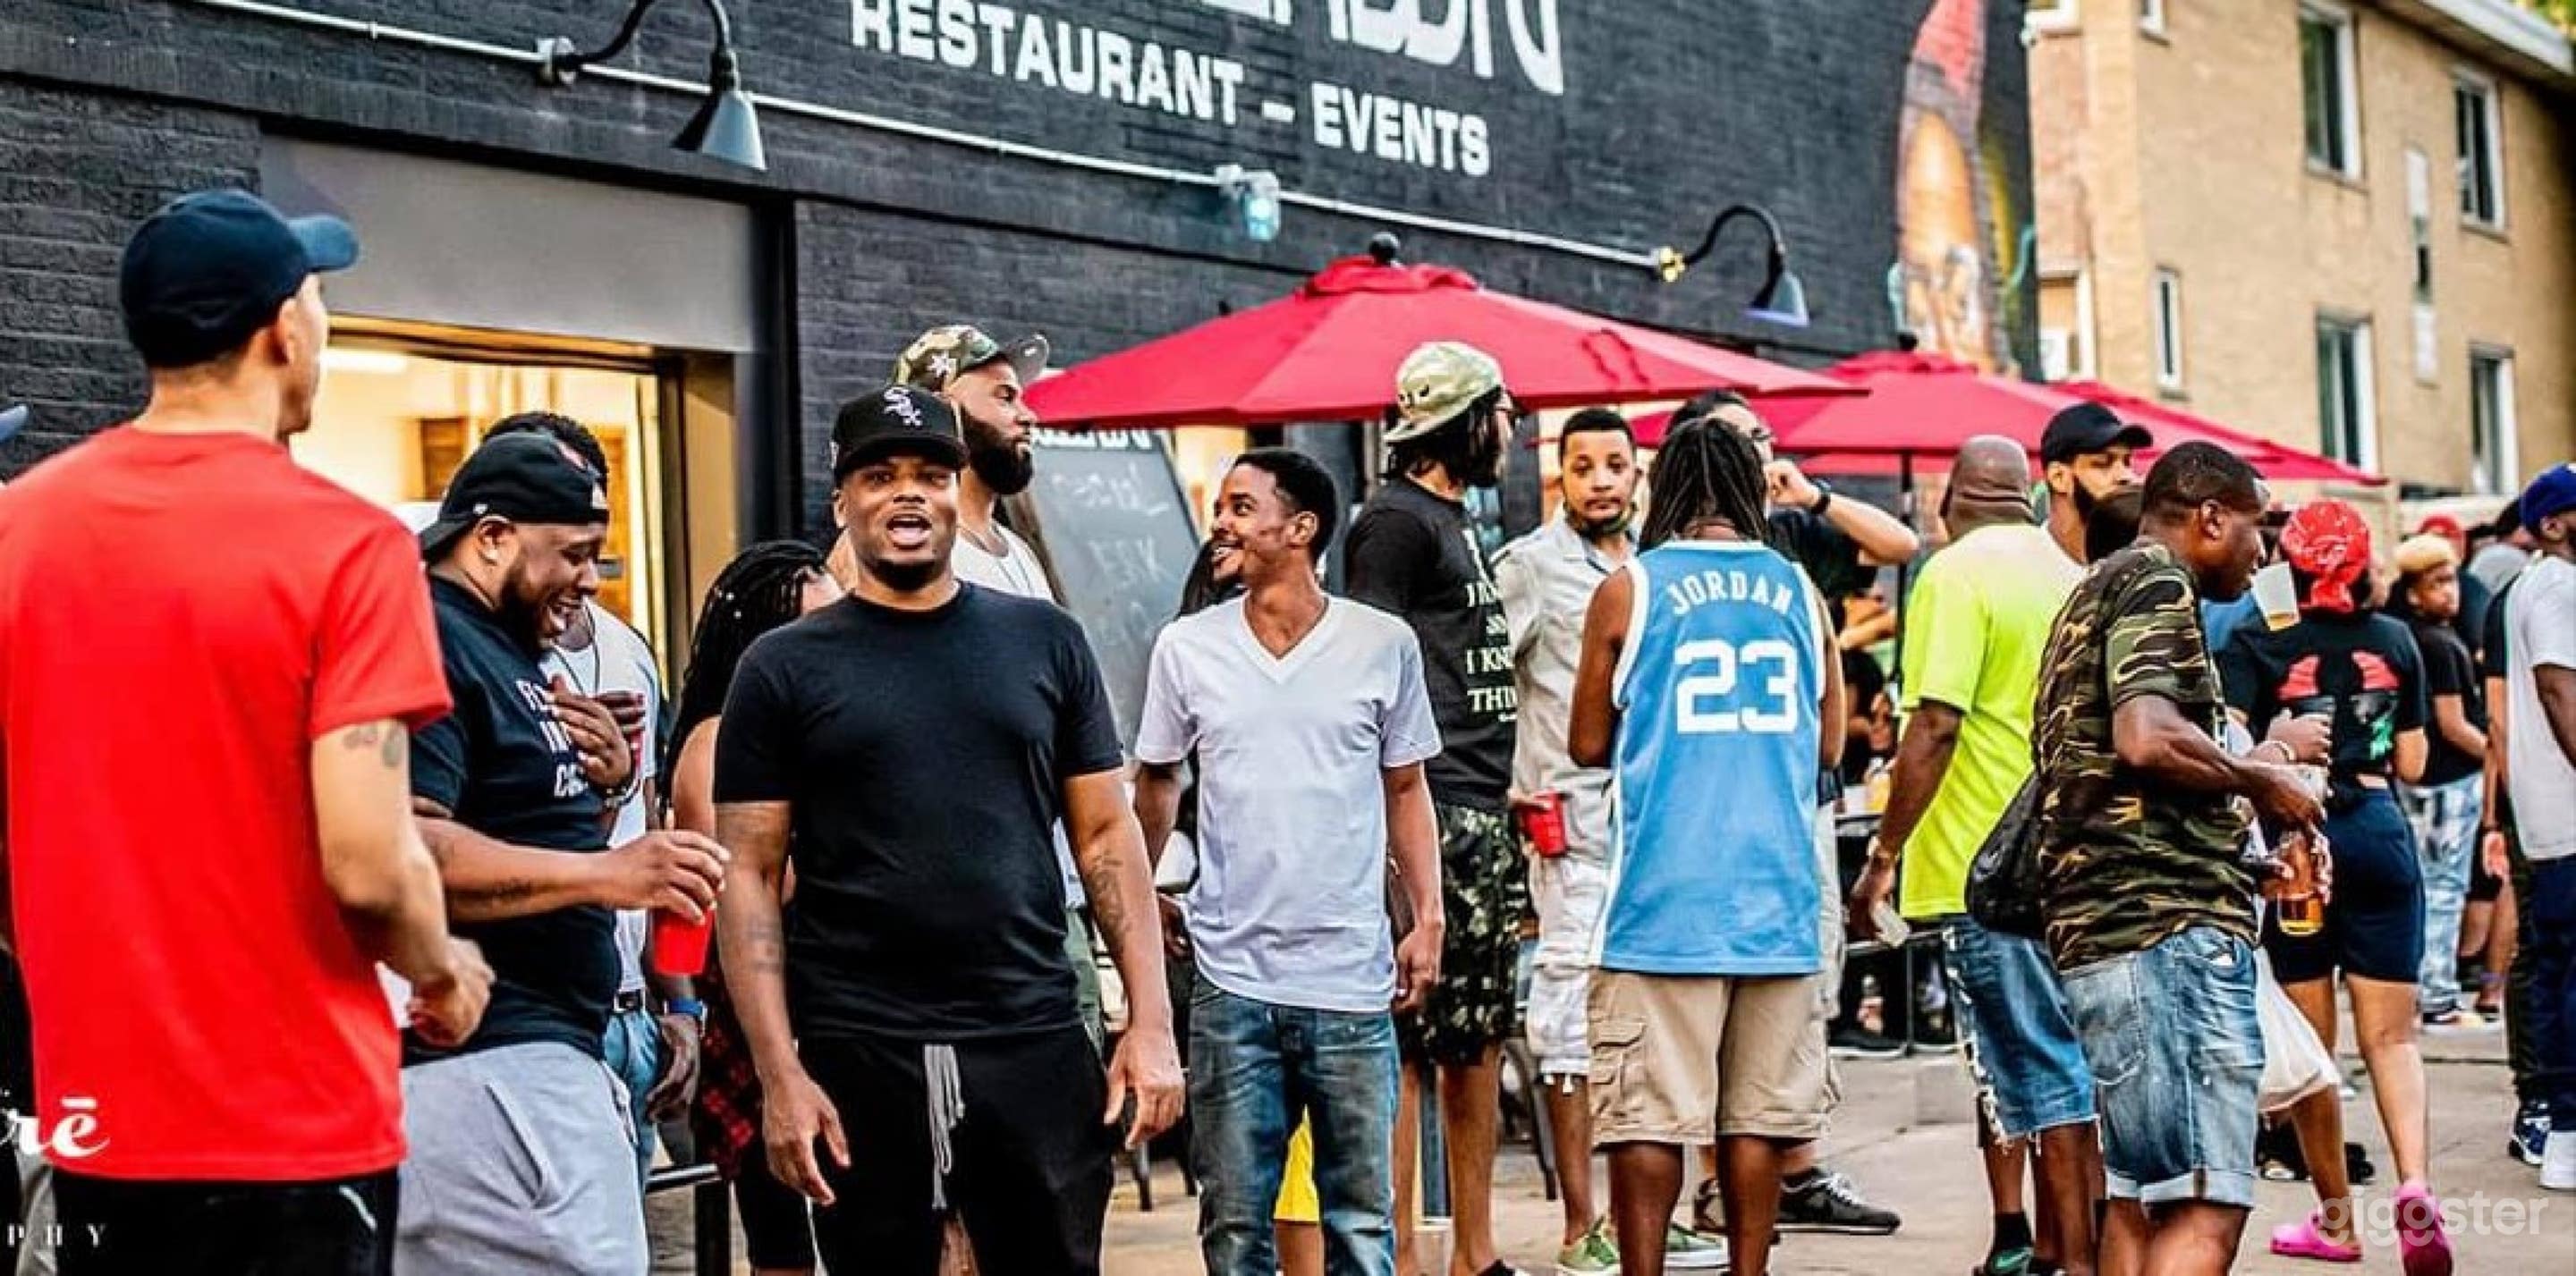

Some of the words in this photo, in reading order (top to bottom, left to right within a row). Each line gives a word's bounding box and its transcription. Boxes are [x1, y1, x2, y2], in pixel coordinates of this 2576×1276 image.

[852, 0, 1244, 125] RESTAURANT
[1311, 82, 1490, 176] EVENTS
[1666, 570, 1793, 616] JORDAN
[1674, 639, 1798, 734] 23
